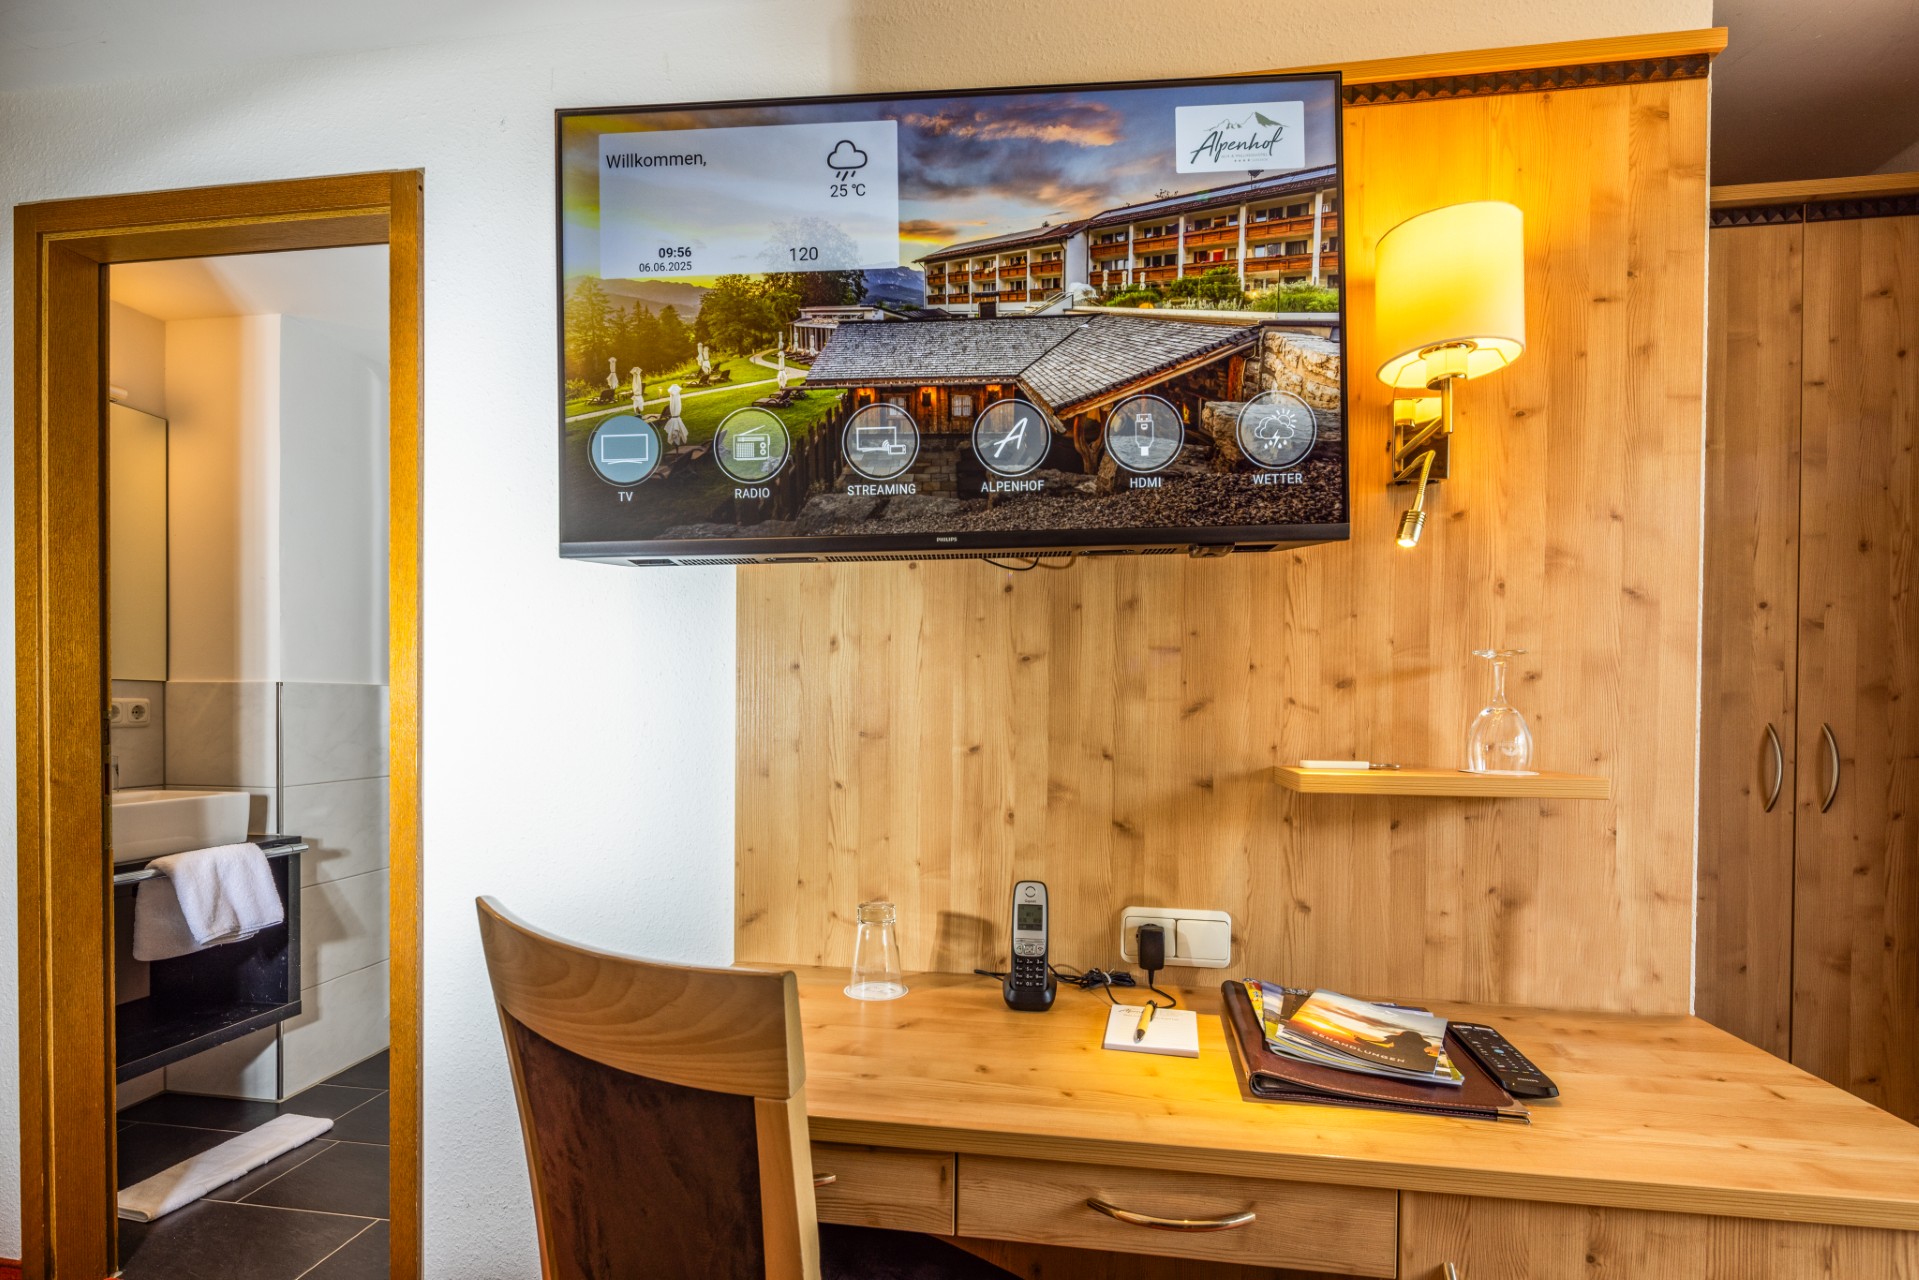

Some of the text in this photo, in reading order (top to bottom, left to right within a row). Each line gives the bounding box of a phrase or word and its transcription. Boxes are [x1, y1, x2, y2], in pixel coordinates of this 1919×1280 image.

[1190, 126, 1284, 165] Alpenhof
[605, 152, 707, 169] Willkommen,
[830, 184, 848, 198] 25
[658, 247, 692, 259] 09:56
[789, 246, 819, 262] 120
[638, 261, 692, 273] 06.06.2025
[1130, 477, 1162, 488] HDMI
[1252, 472, 1303, 485] WETTER
[847, 483, 916, 496] STREAMING
[981, 479, 1045, 493] ALPENHOF
[617, 491, 634, 502] TV
[734, 487, 770, 499] RADIO
[1311, 1030, 1406, 1063] BEHANDLUNGEN
